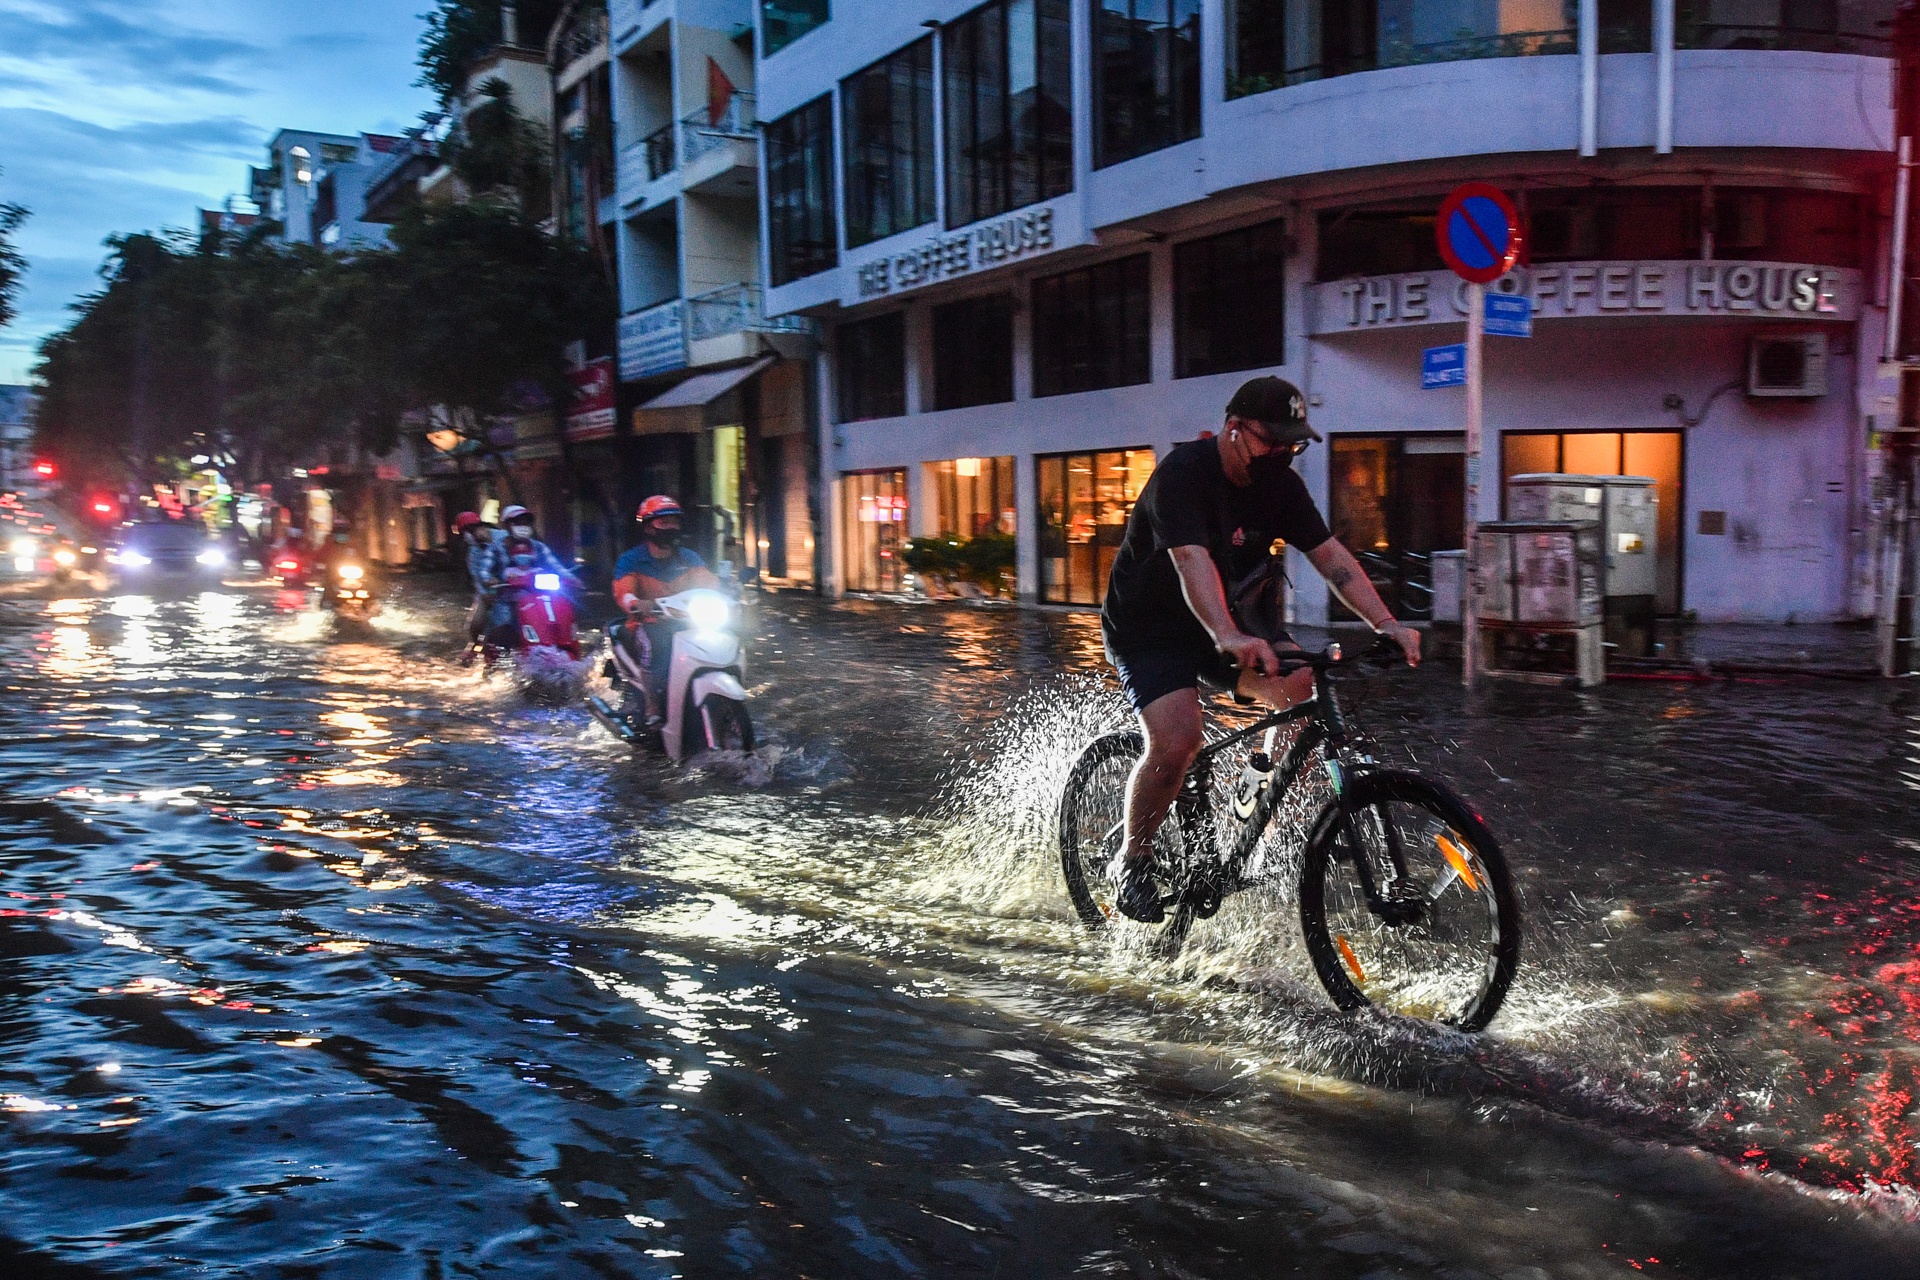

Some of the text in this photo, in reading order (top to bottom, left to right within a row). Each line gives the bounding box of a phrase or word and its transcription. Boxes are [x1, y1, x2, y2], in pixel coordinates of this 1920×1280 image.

[859, 207, 1054, 295] THE COFFEE HOUSE
[1341, 276, 1430, 325] THE
[1687, 265, 1840, 313] HOUSE
